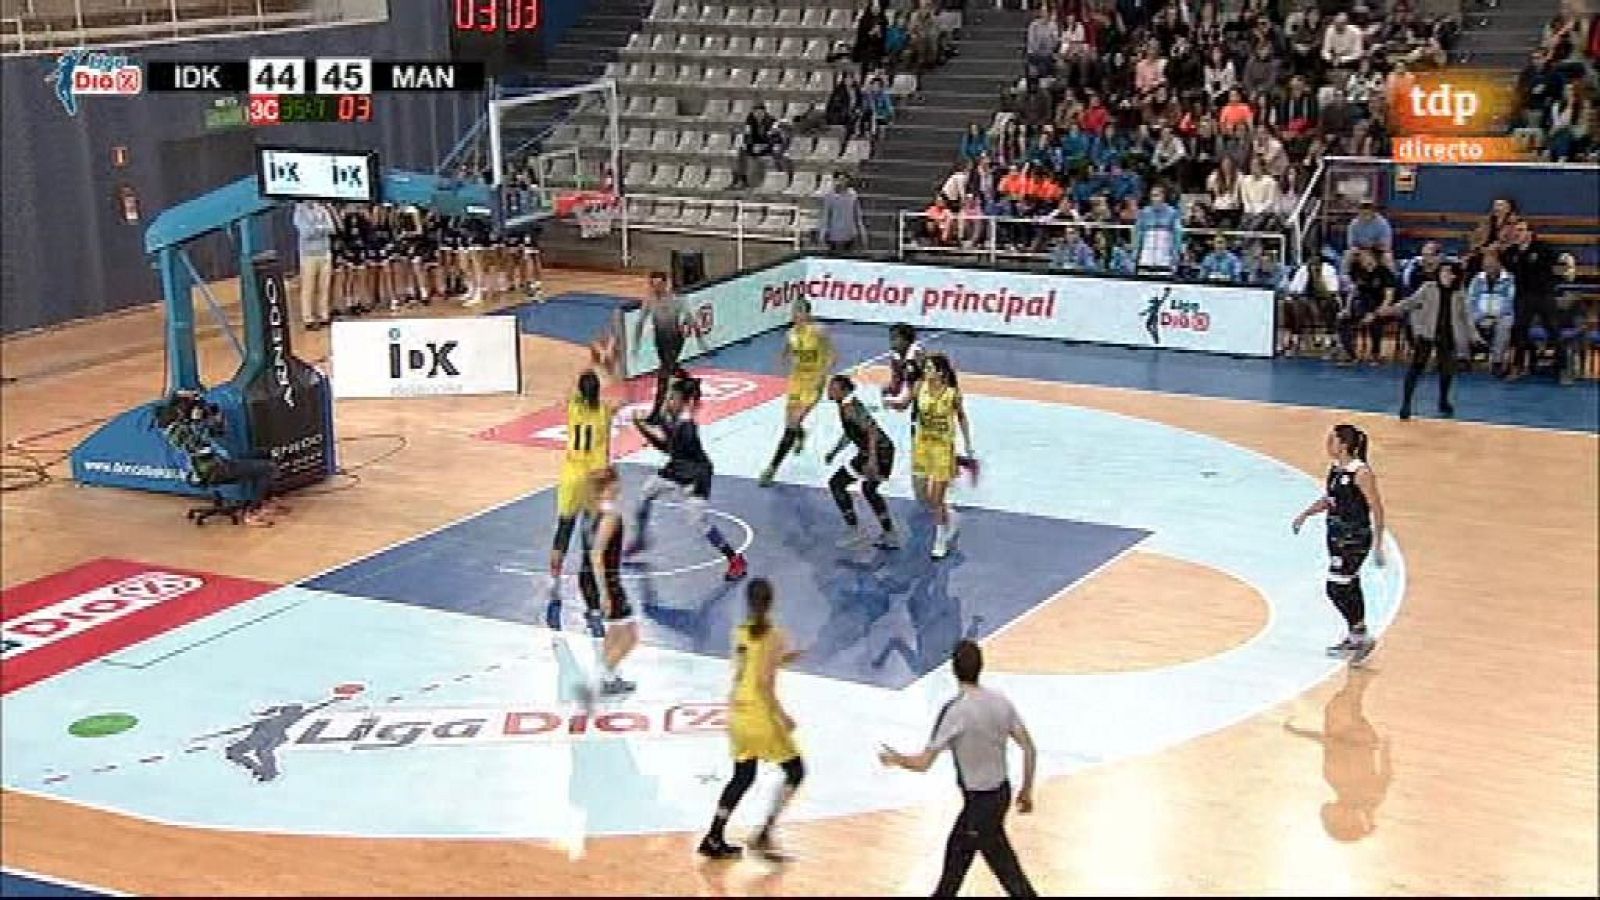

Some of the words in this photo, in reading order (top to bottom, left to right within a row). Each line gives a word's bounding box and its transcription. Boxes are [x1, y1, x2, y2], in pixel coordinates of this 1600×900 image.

[762, 273, 915, 312] Patrocinador
[921, 283, 1058, 323] principal
[573, 424, 593, 454] 11
[297, 716, 488, 751] Liga
